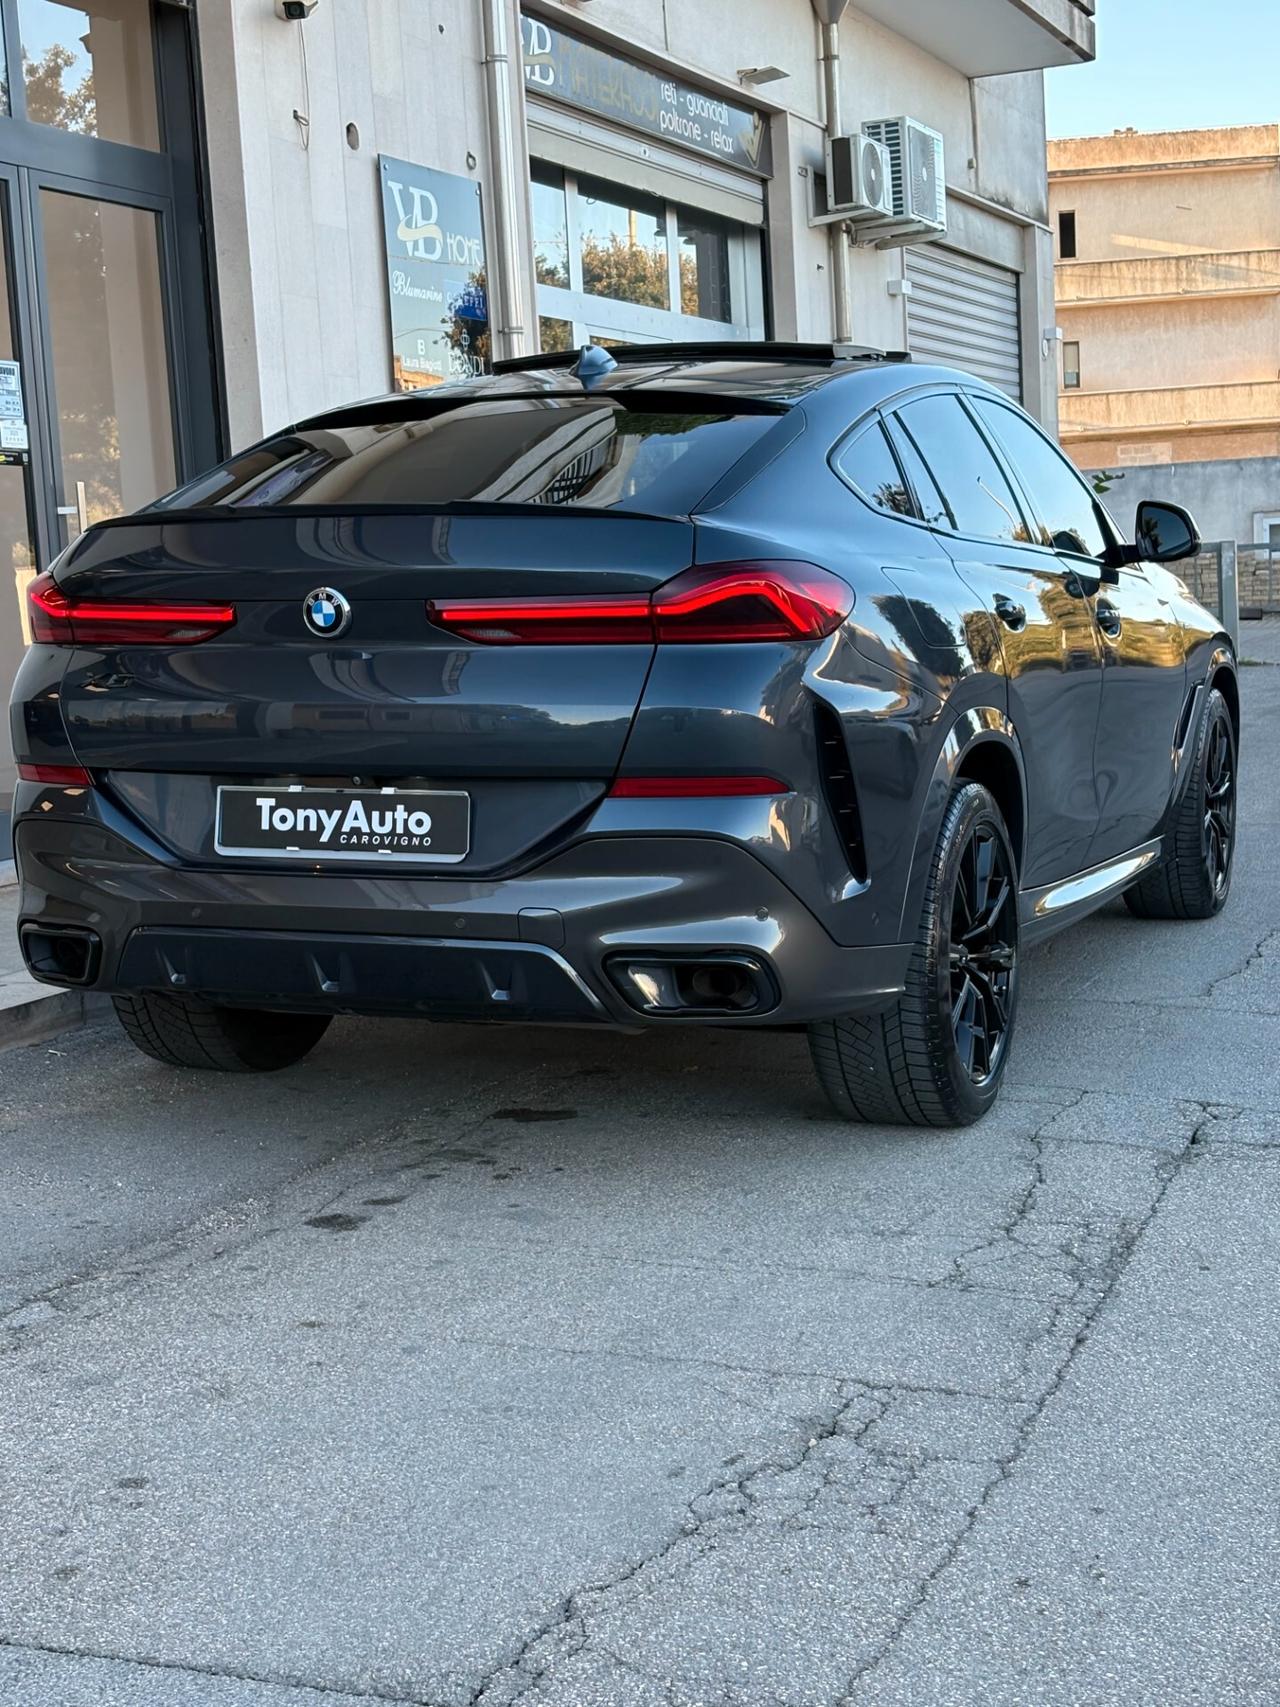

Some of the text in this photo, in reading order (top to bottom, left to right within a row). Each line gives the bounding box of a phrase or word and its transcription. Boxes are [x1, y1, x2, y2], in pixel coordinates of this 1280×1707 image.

[660, 82, 677, 105] reti
[686, 94, 729, 126] guanciali
[660, 107, 701, 140] poltrone
[710, 126, 734, 154] relax
[446, 231, 482, 266] HOME
[308, 592, 341, 606] BMW
[255, 797, 432, 842] TonyAuto
[340, 834, 432, 846] CAROVIGNO
